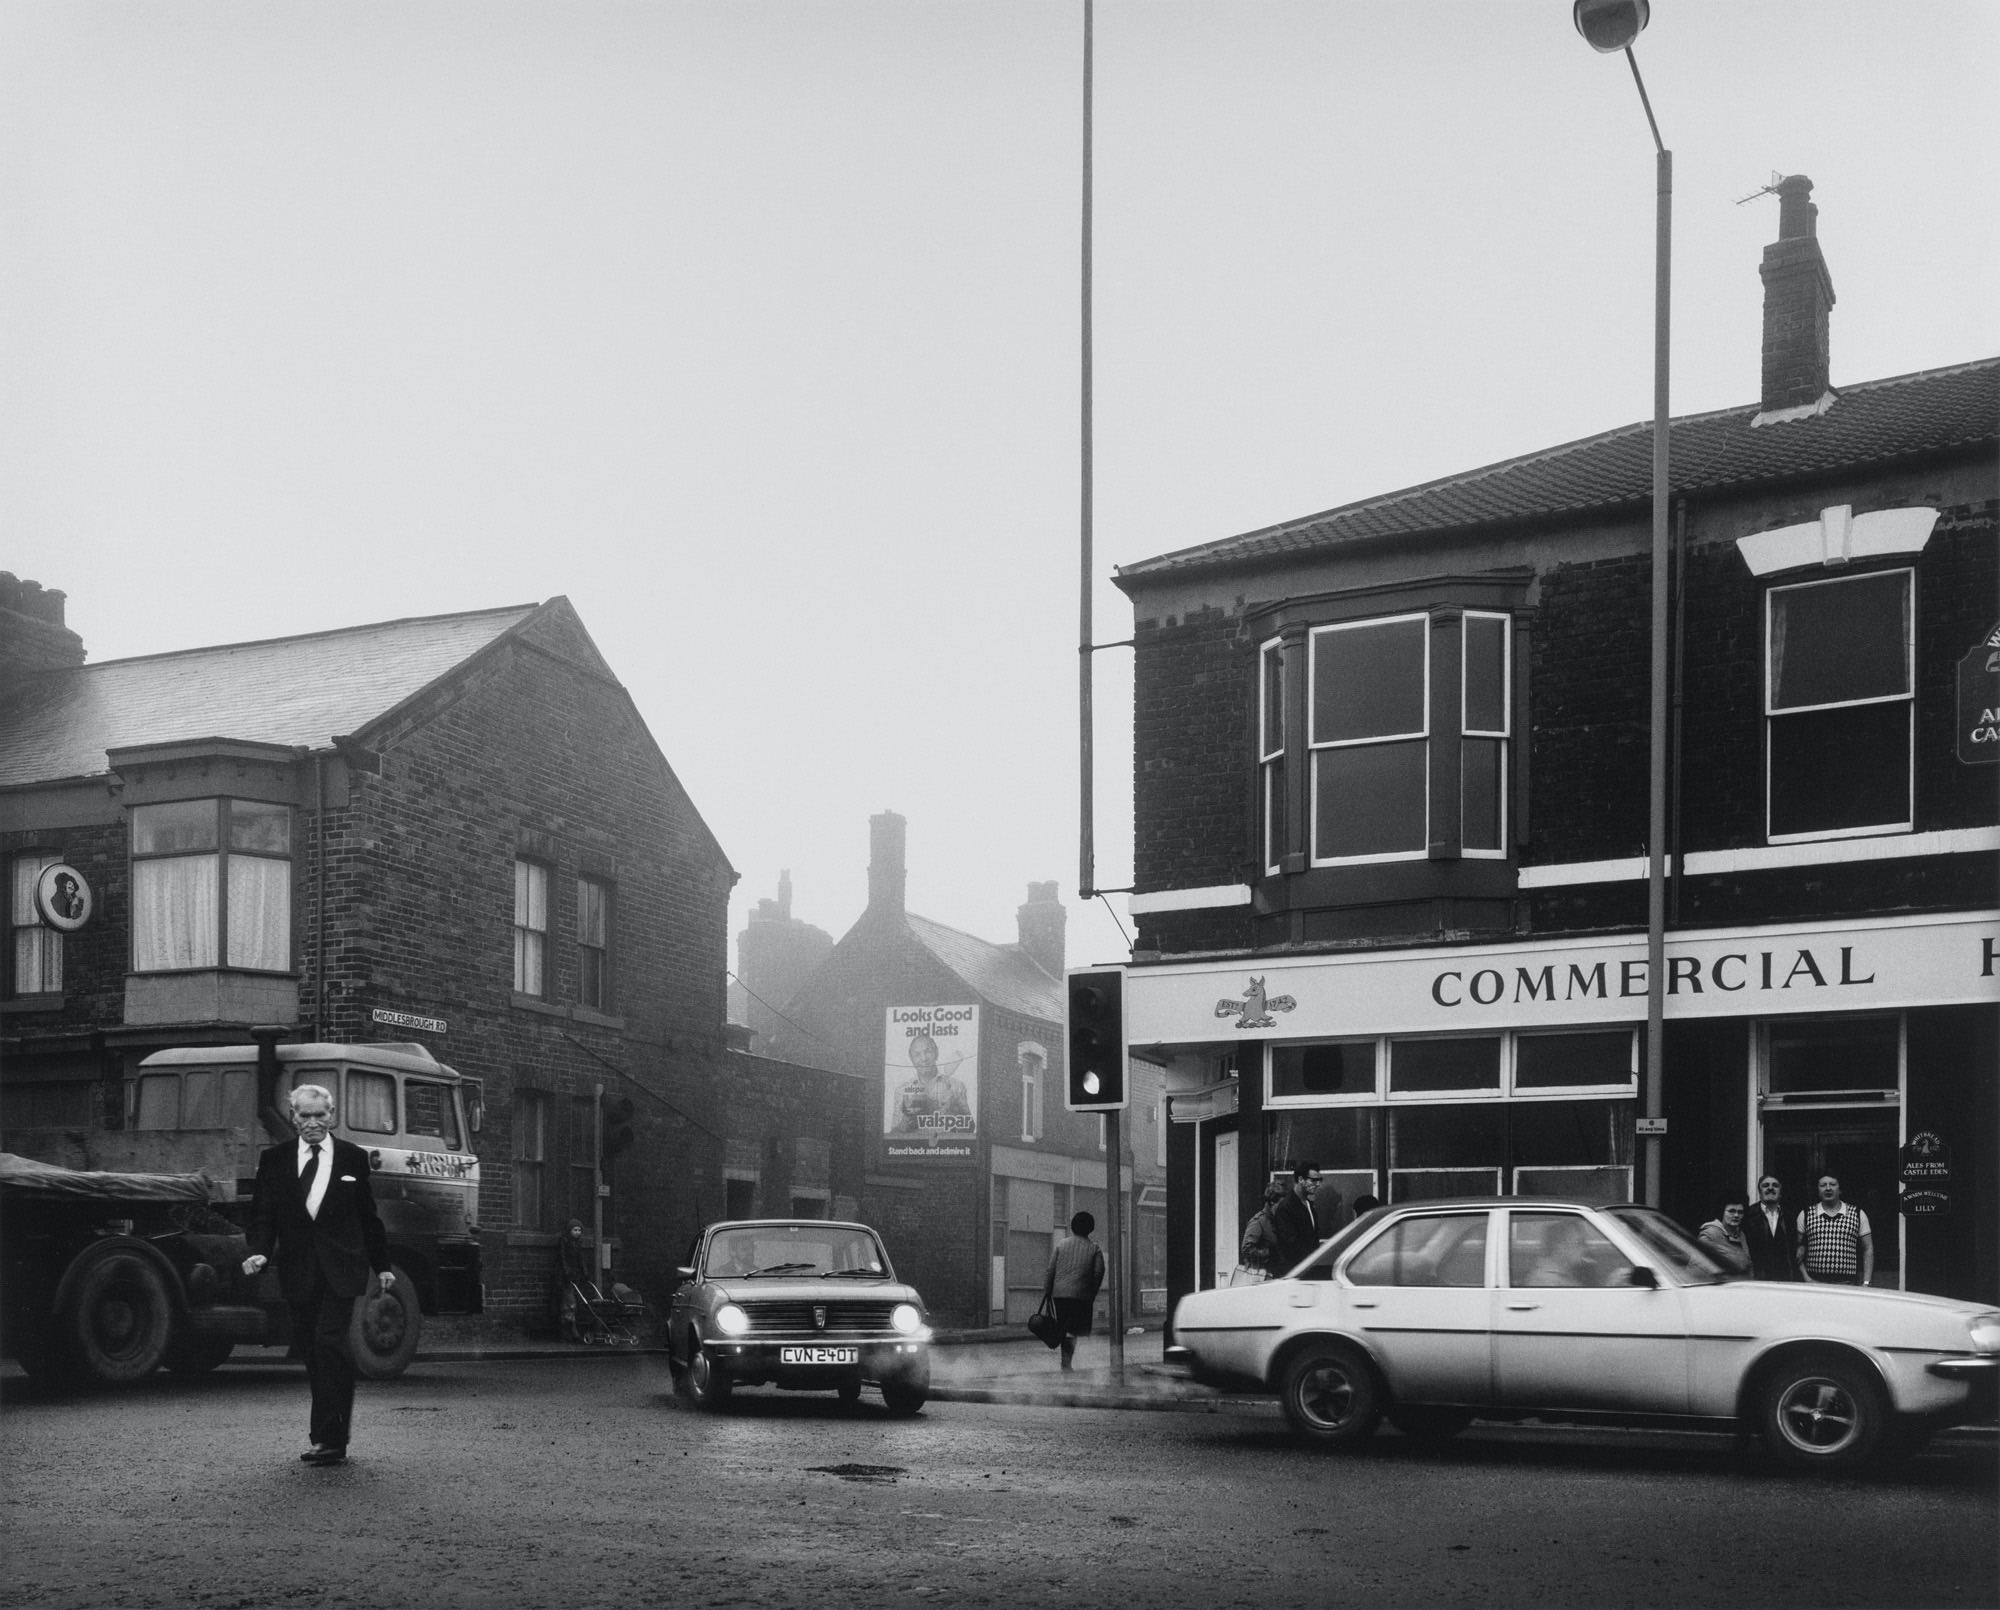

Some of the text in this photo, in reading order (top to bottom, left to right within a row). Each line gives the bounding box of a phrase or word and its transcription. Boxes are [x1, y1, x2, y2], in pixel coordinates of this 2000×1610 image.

[1431, 946, 1876, 1007] COMMERCIAL
[374, 1010, 446, 1032] MIDDLESBROUGH RD
[893, 1006, 972, 1023] Looks Good
[905, 1022, 959, 1037] and lasts
[917, 1111, 973, 1132] valspar
[888, 1146, 971, 1155] Stand back and admire it
[783, 1348, 857, 1362] CVN 240T
